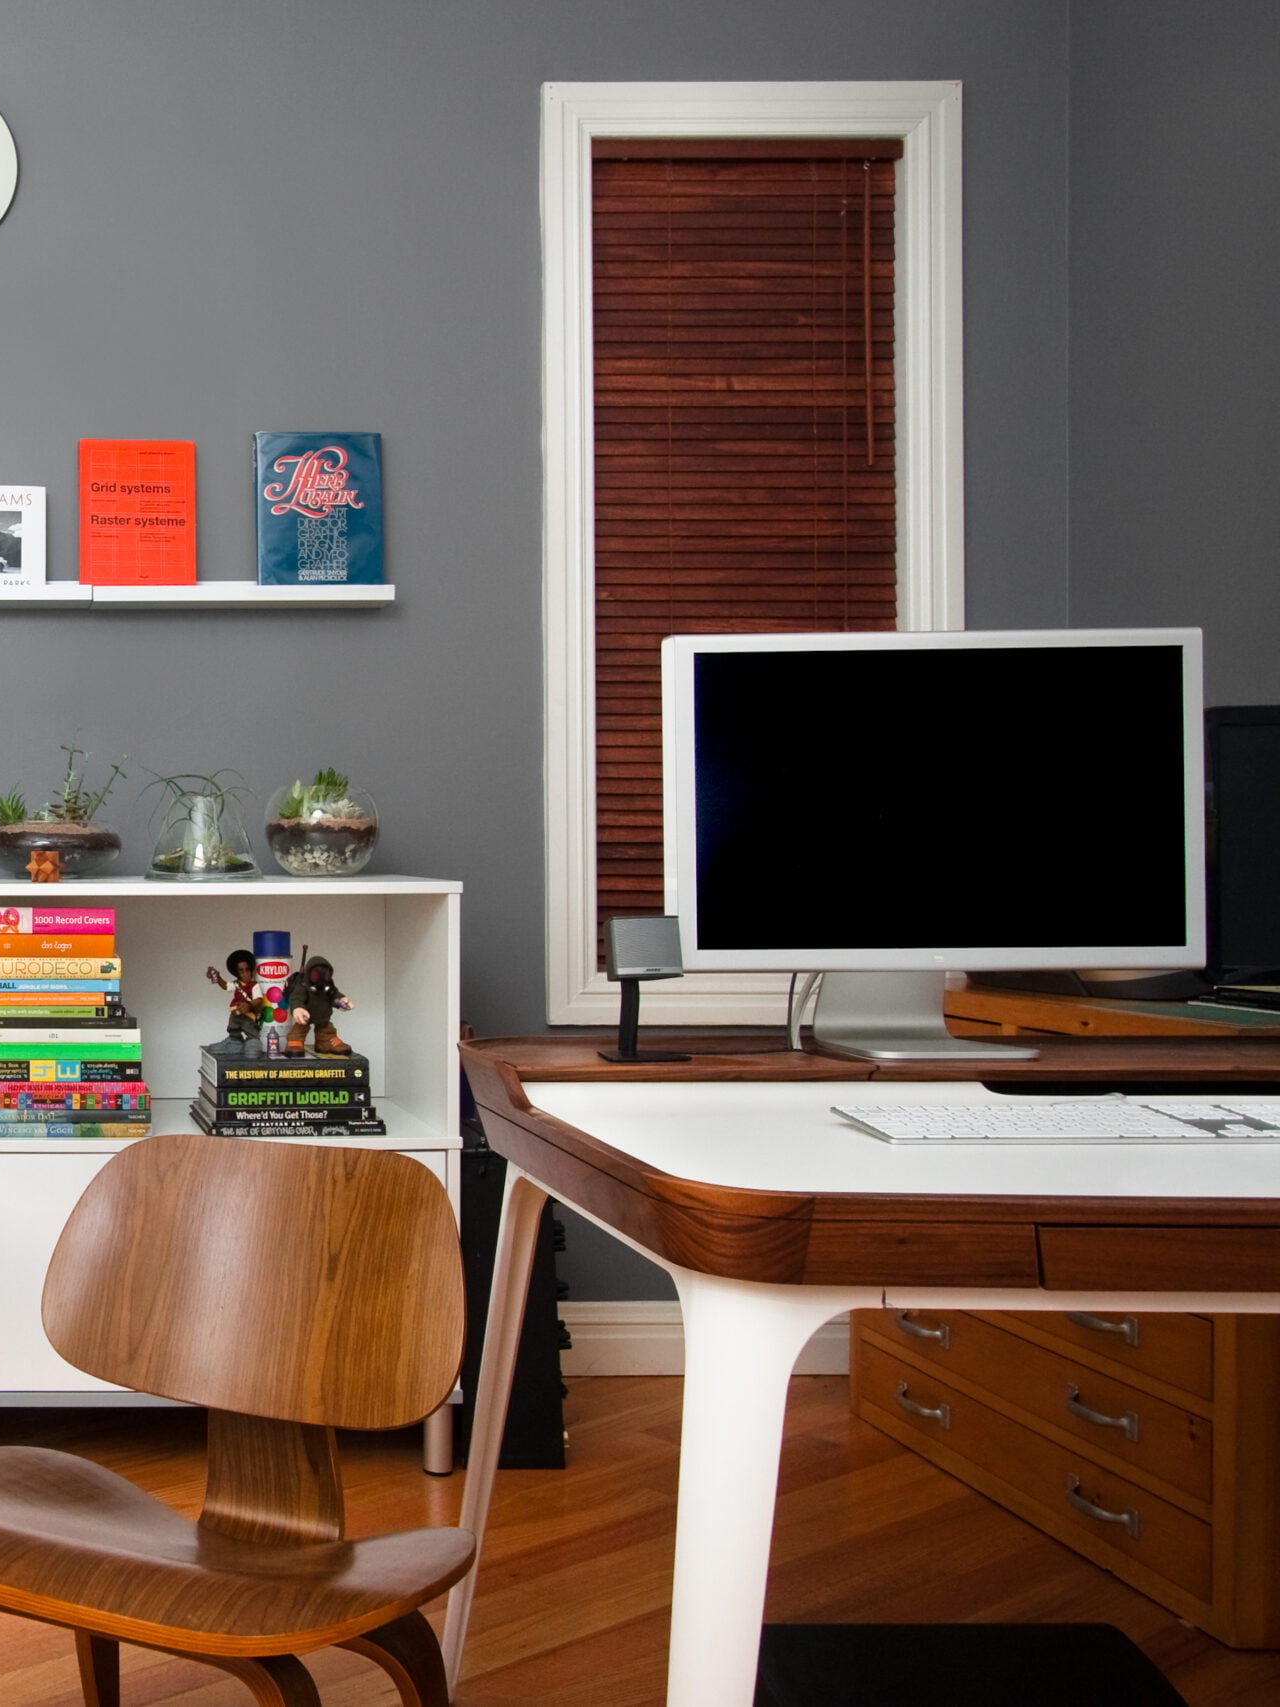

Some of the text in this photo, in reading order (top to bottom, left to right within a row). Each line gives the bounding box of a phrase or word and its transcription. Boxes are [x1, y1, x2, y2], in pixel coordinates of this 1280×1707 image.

[264, 446, 350, 501] HERB
[91, 482, 171, 494] Grid systems
[329, 508, 348, 518] ART
[91, 515, 186, 527] Raster systeme
[297, 518, 347, 529] DIRECTOR
[297, 528, 347, 539] GRAPHIC
[297, 539, 348, 549] DESIGNER
[297, 559, 348, 570] GRAPHER
[34, 916, 110, 924] 1000 Record Covers
[260, 966, 287, 974] KRYLON
[225, 1069, 346, 1079] THE HISTORY OF AMERICAN GRAFFITI
[228, 1091, 349, 1105] GRAFFITI WORLD
[301, 1111, 328, 1119] Those?
[0, 1126, 32, 1134] VINCENT
[220, 1127, 233, 1135] THE
[235, 1127, 248, 1135] ART
[250, 1127, 260, 1135] OF
[261, 1127, 294, 1135] GETTING
